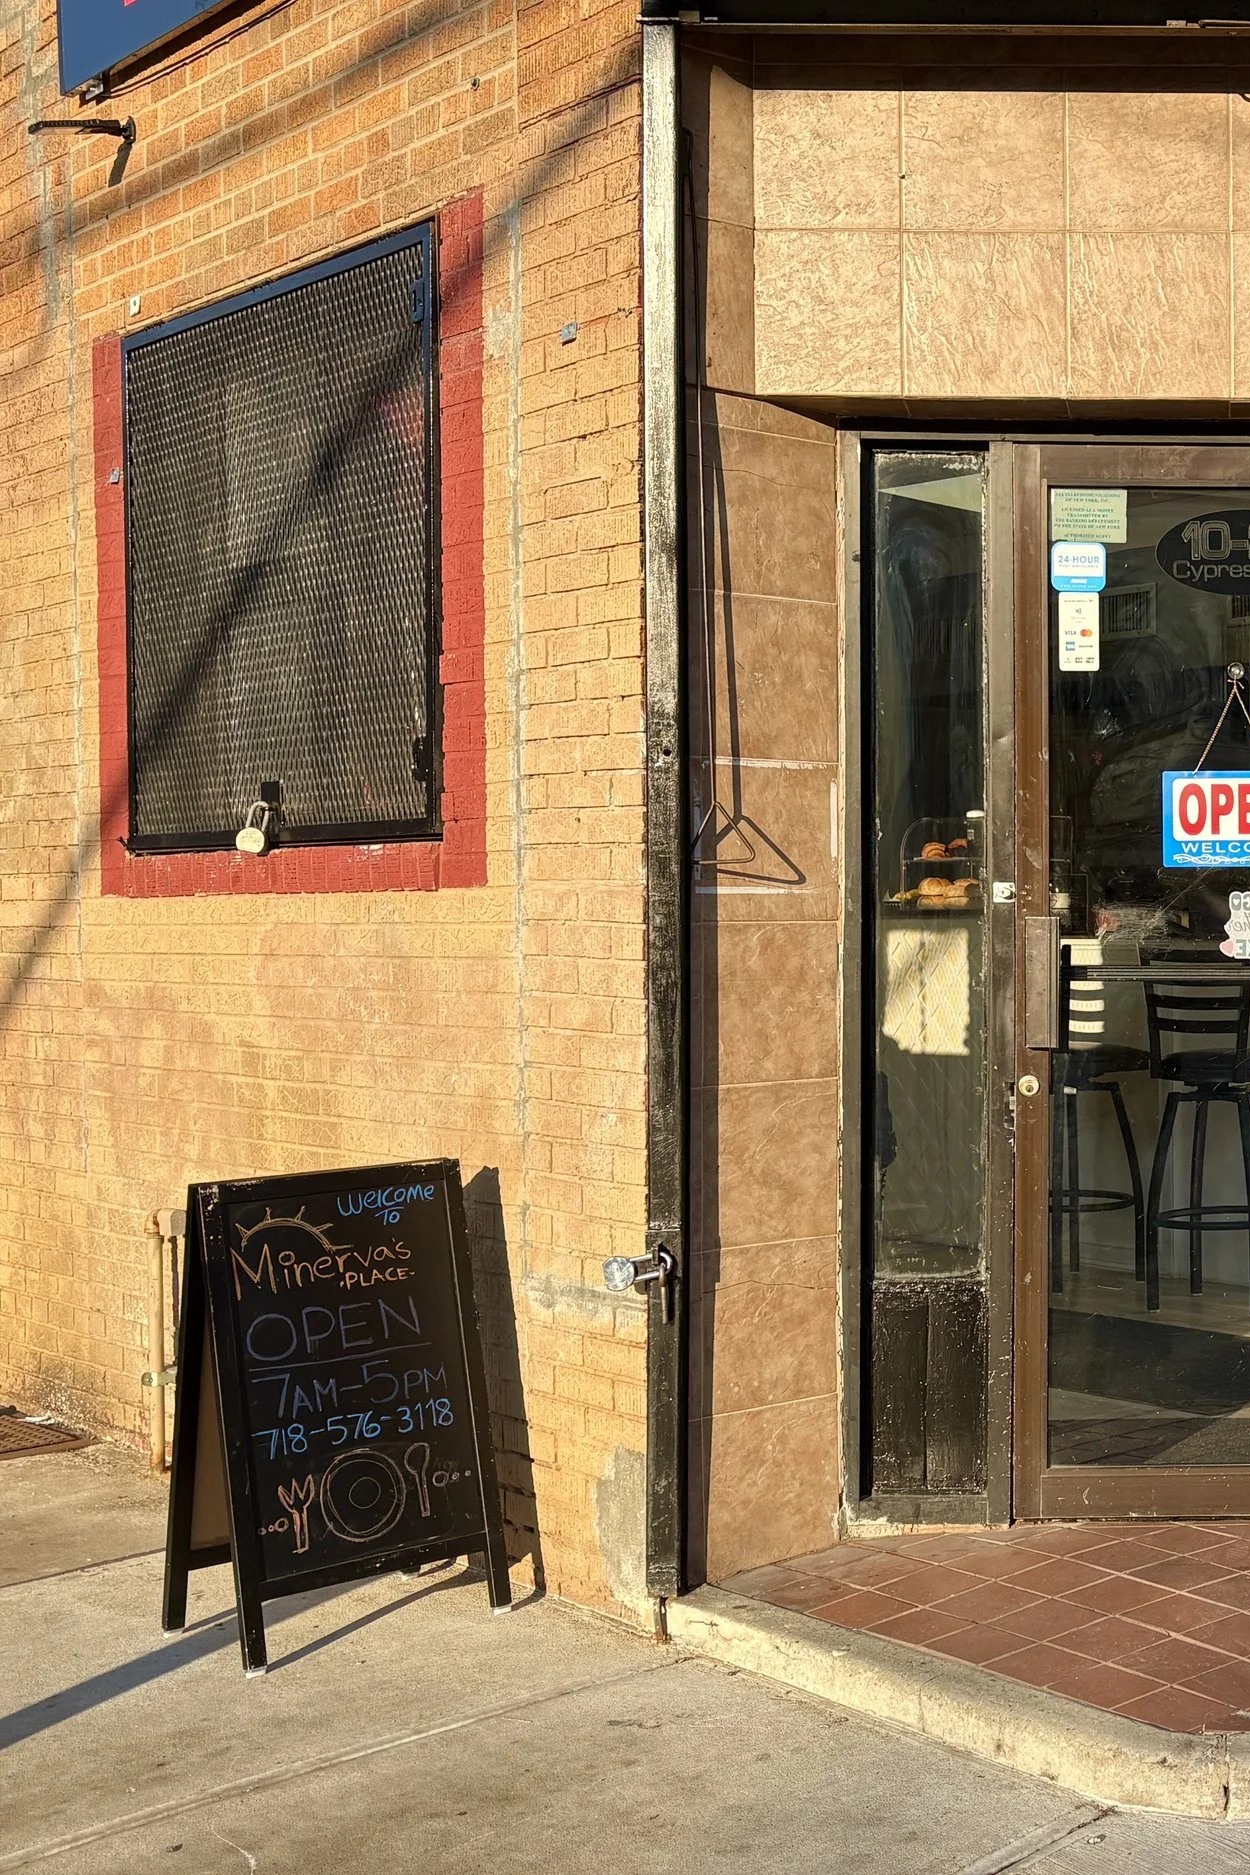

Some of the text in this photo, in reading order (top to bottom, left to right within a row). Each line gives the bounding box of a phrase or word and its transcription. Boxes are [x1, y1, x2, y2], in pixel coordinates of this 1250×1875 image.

[230, 1237, 412, 1300] Minerva's
[246, 1296, 422, 1362] OPEN
[252, 1398, 454, 1460] 718-576-3118
